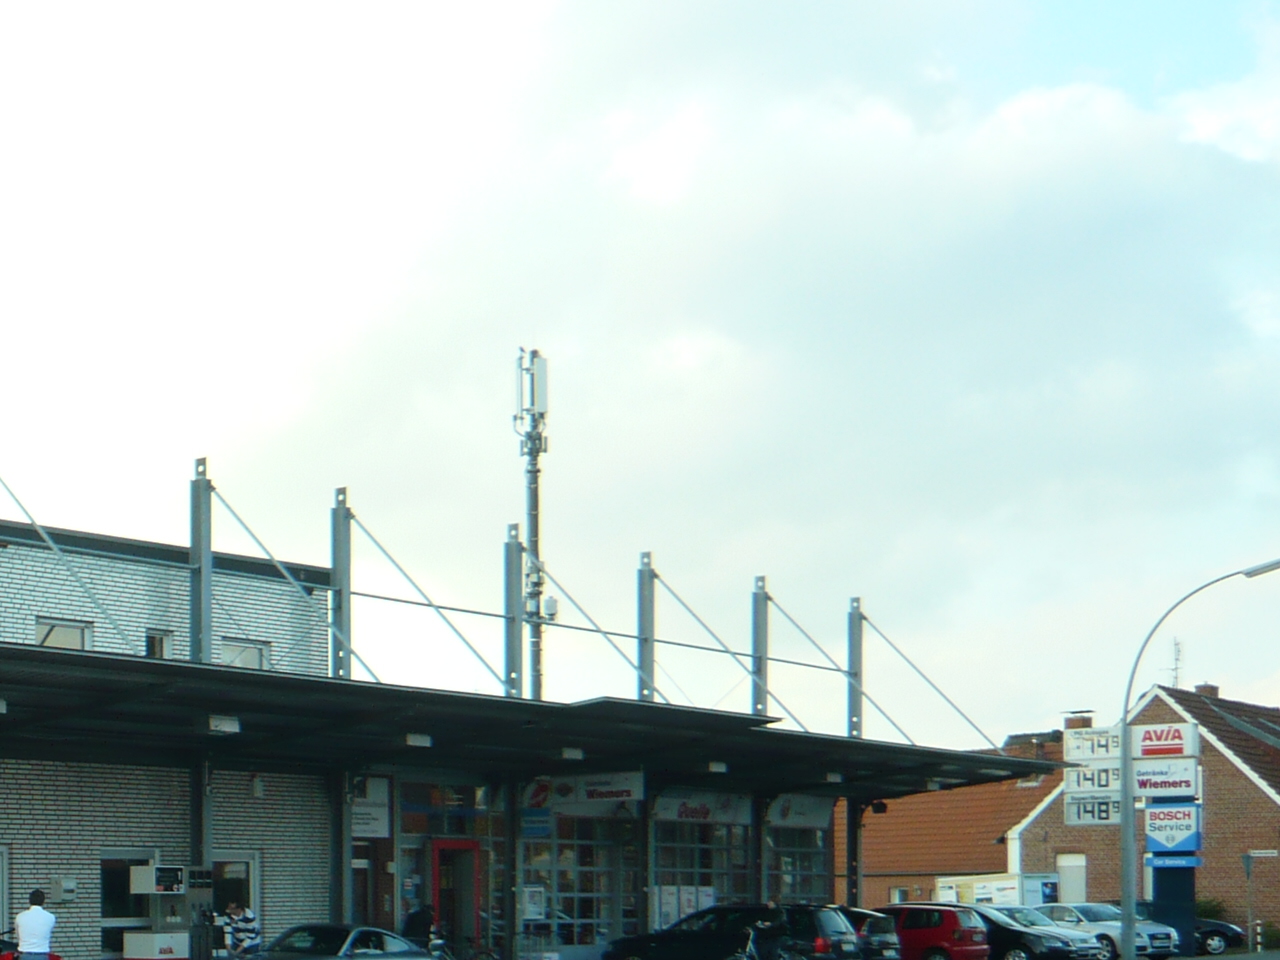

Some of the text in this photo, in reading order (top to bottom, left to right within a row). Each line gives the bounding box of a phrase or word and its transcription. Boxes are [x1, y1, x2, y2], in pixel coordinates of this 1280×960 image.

[1137, 778, 1192, 790] Wiemers
[1149, 810, 1191, 821] BOSCH
[1148, 821, 1193, 832] Service
